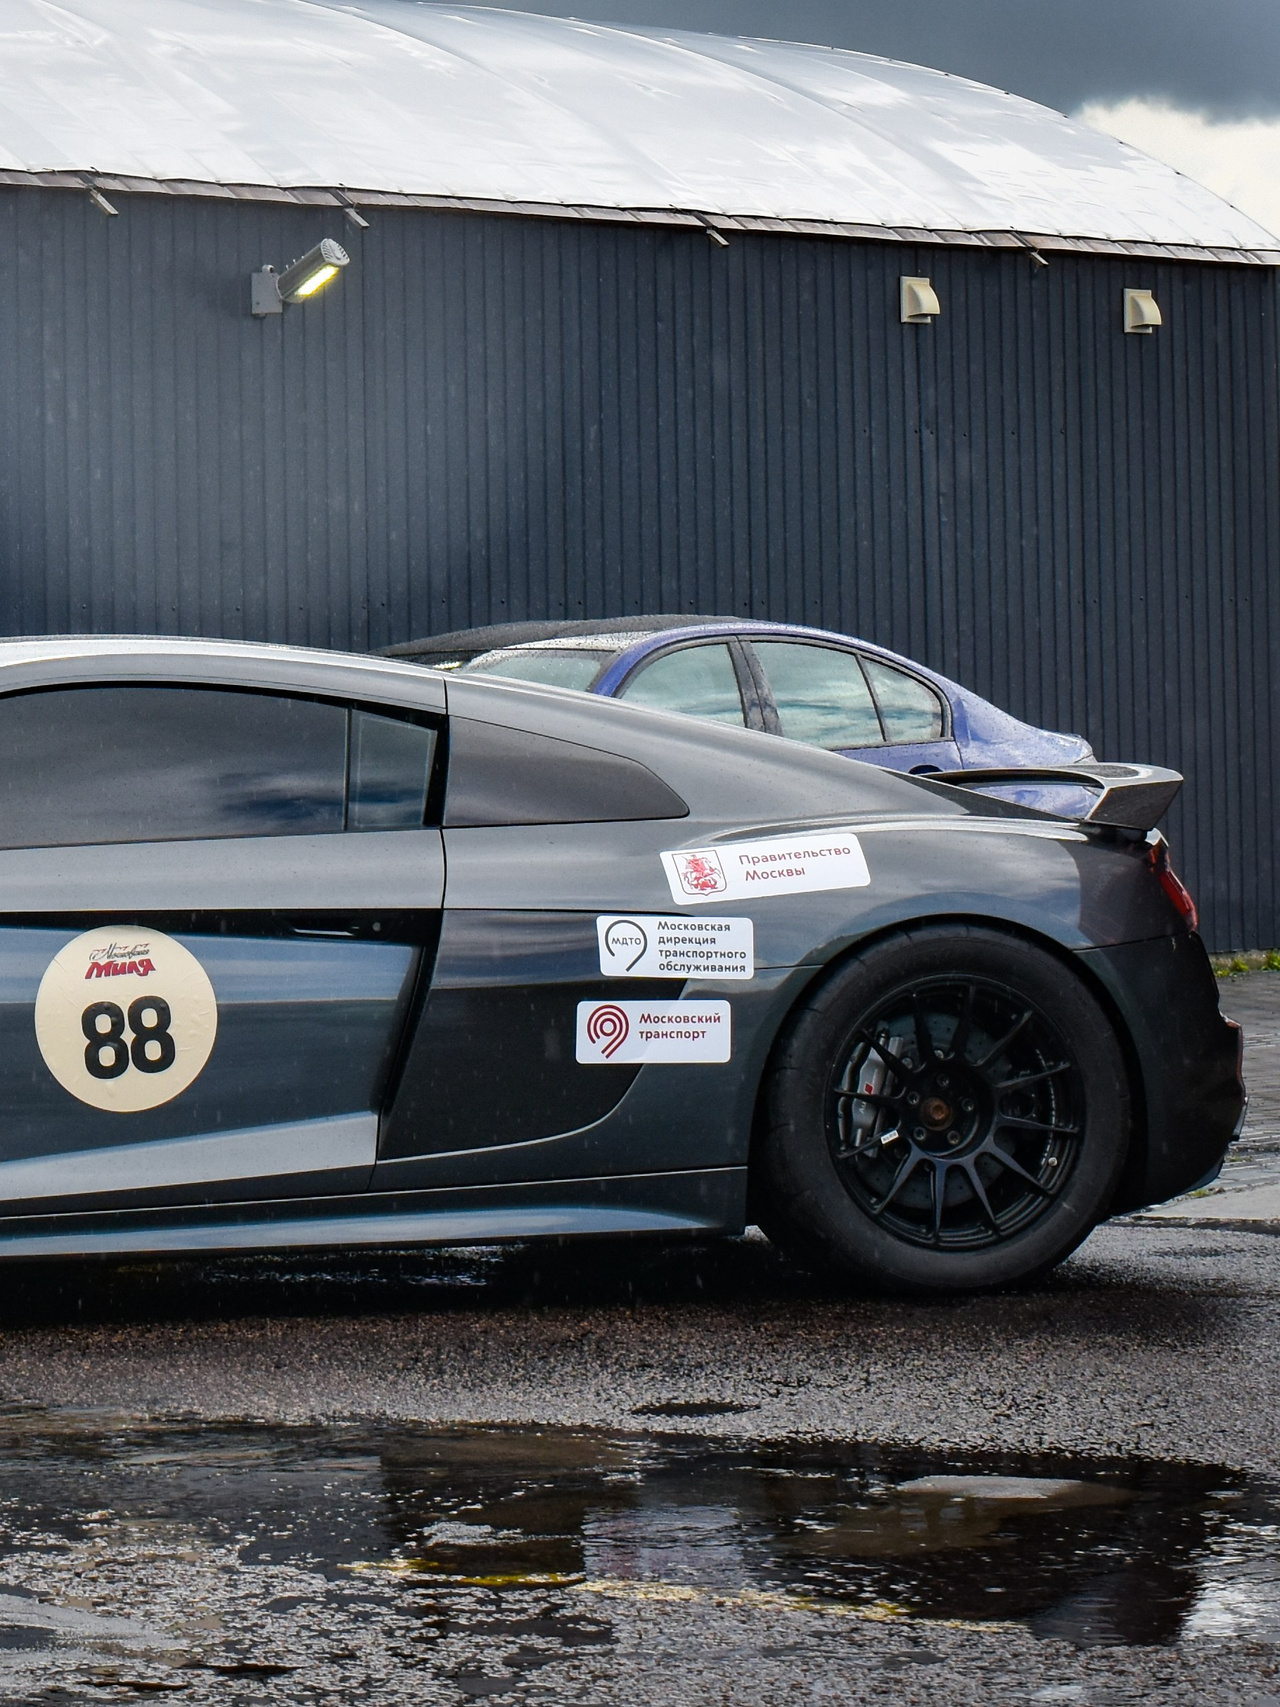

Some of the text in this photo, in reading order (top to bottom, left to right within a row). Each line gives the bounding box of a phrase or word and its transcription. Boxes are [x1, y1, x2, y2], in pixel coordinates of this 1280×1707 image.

[738, 847, 851, 866] Правительство
[745, 867, 806, 881] Москвы
[657, 921, 731, 932] Московская
[611, 937, 642, 946] МДТО
[658, 936, 717, 946] дирекция
[658, 948, 747, 960] транспортного
[658, 960, 746, 973] обслуживания
[639, 1012, 721, 1024] Московский
[81, 995, 176, 1080] 88
[639, 1030, 707, 1041] транспорт
